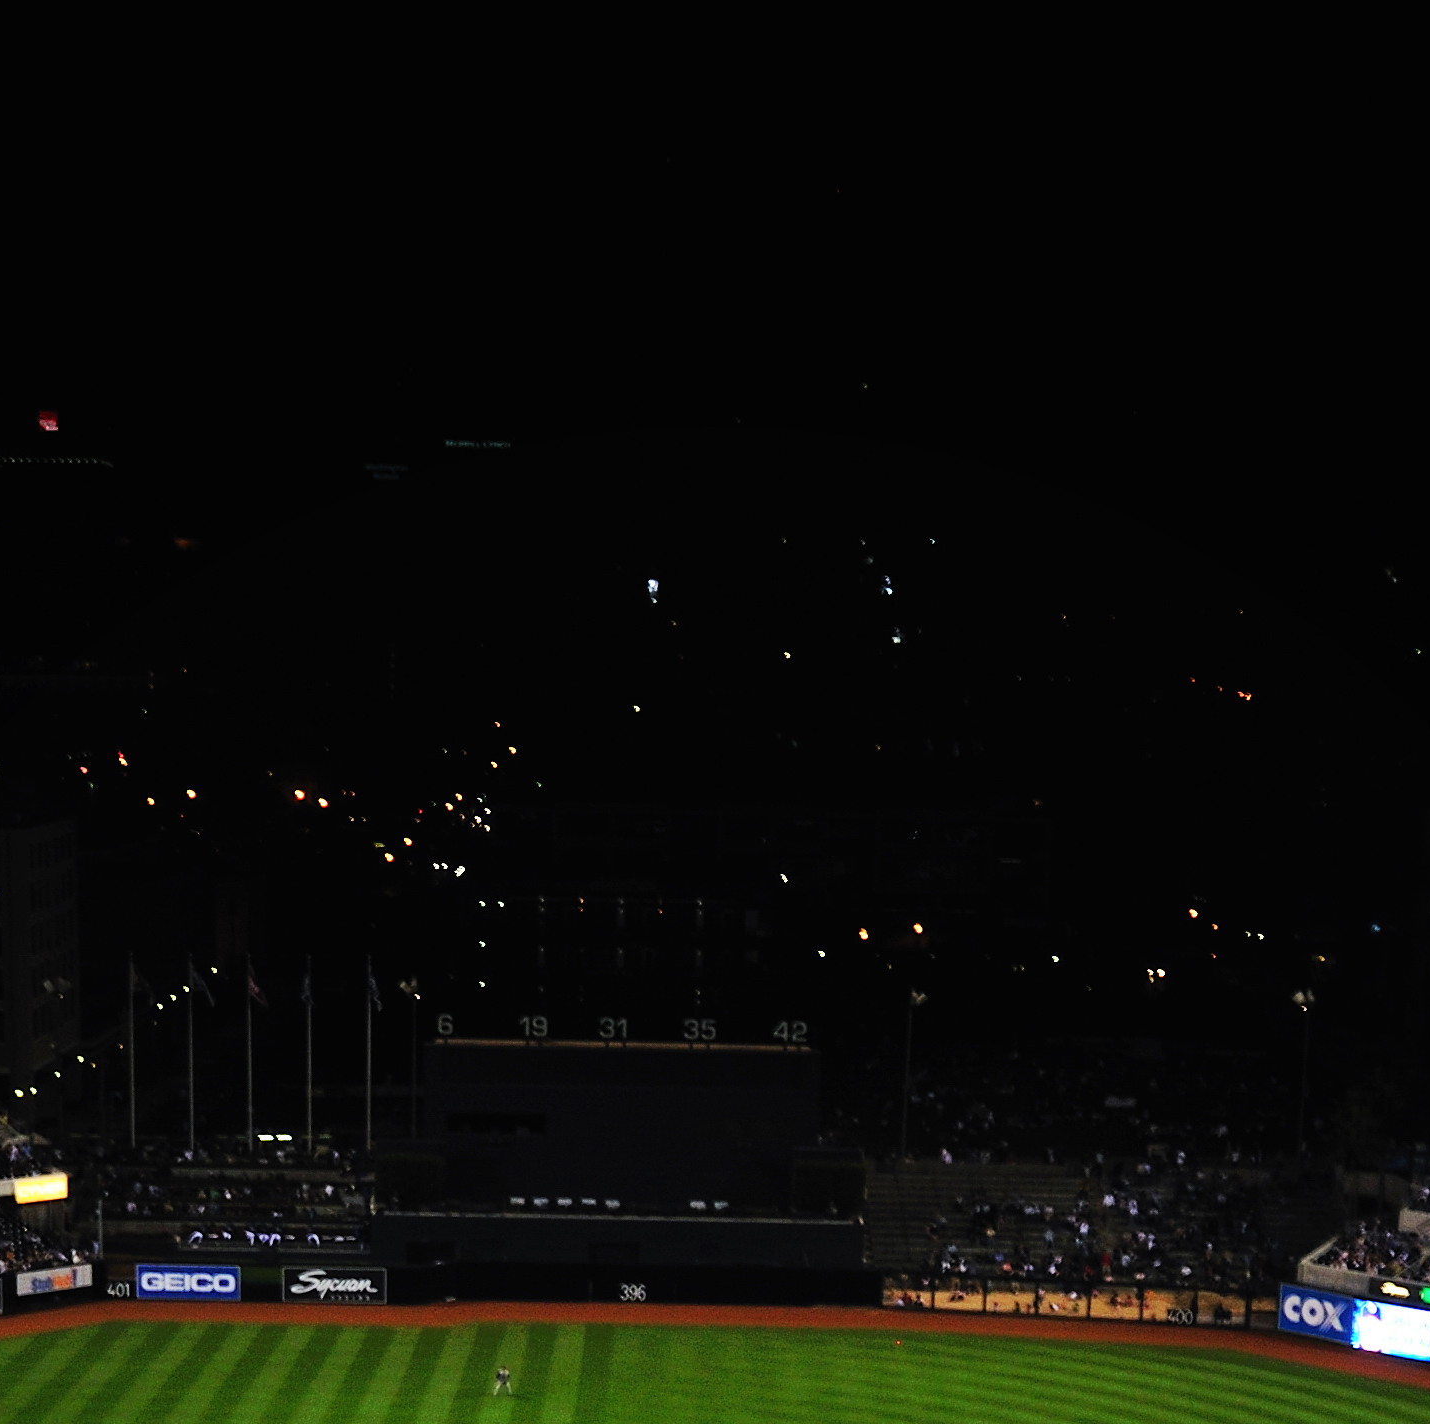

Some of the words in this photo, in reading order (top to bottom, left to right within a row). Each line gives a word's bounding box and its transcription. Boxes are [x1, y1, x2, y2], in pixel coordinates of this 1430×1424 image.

[437, 1014, 454, 1035] 6
[520, 1015, 548, 1037] 19
[599, 1017, 629, 1039] 31
[683, 1019, 717, 1040] 35
[774, 1020, 808, 1042] 42
[106, 1282, 130, 1298] 401
[141, 1272, 237, 1294] GEICO
[290, 1269, 379, 1300] Sycuan
[620, 1283, 647, 1302] 396
[1167, 1308, 1194, 1326] 400
[1283, 1294, 1347, 1333] COX
